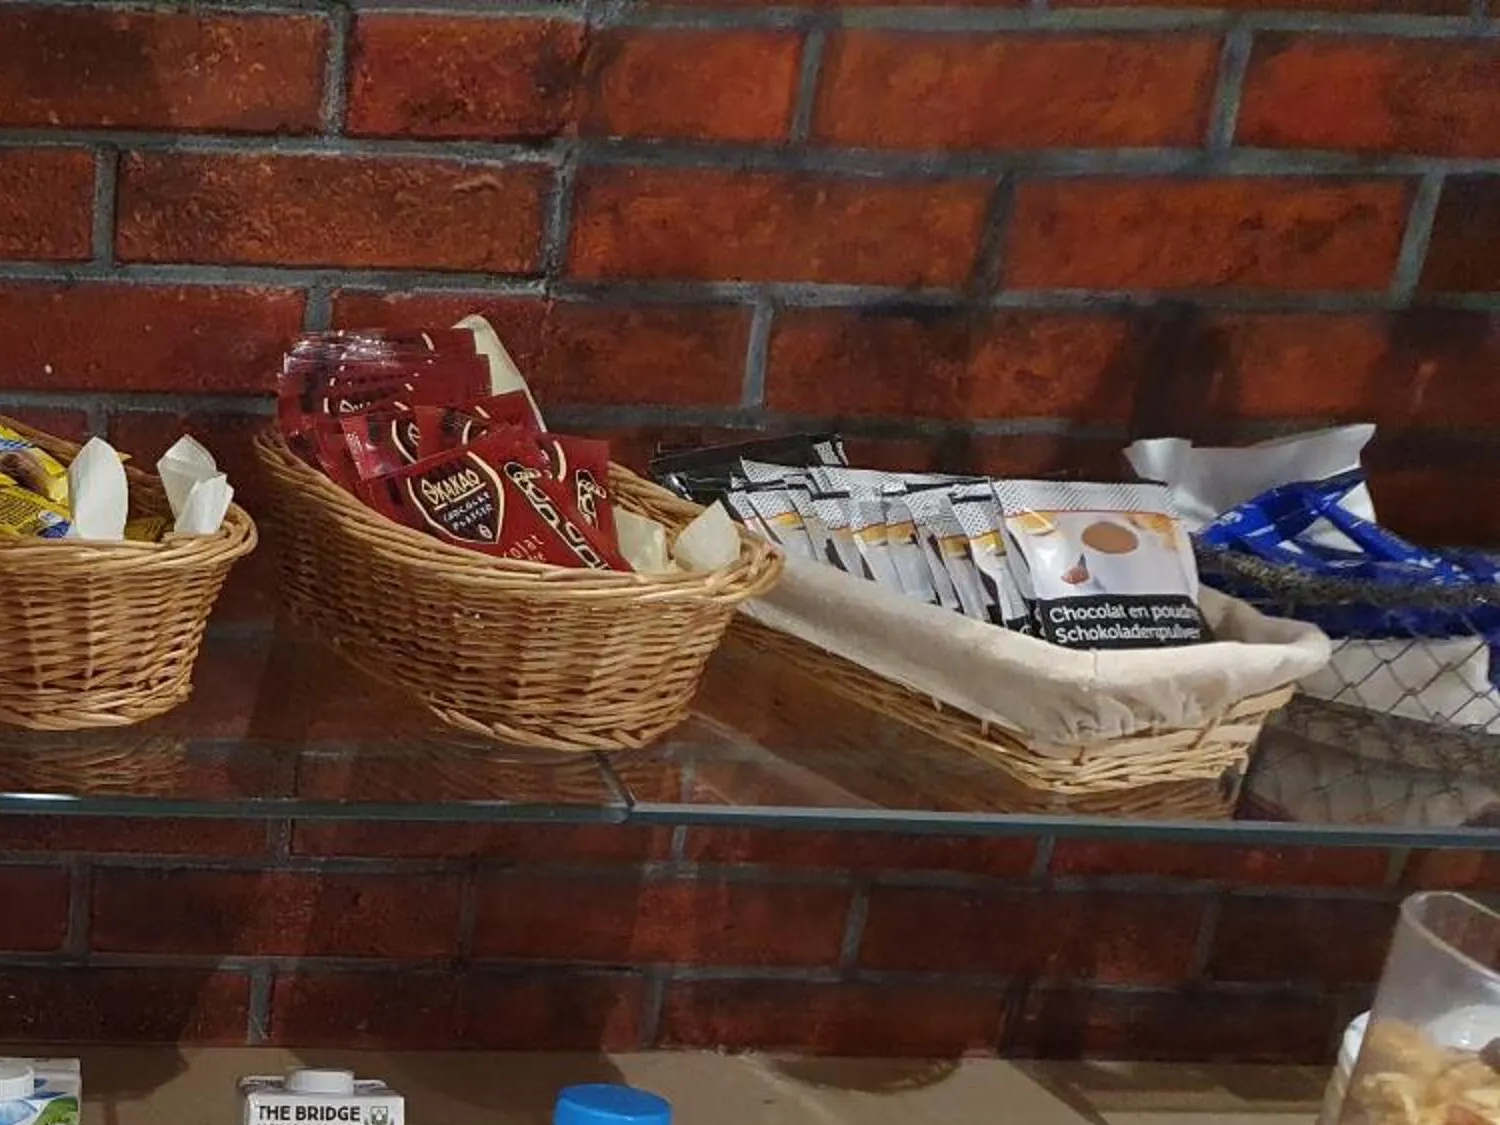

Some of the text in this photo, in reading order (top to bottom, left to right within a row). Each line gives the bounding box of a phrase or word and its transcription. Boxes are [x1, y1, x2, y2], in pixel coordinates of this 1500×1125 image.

[1049, 603, 1126, 623] Chocolat
[1128, 606, 1150, 619] en
[258, 1106, 361, 1121] THE BRIDGE
